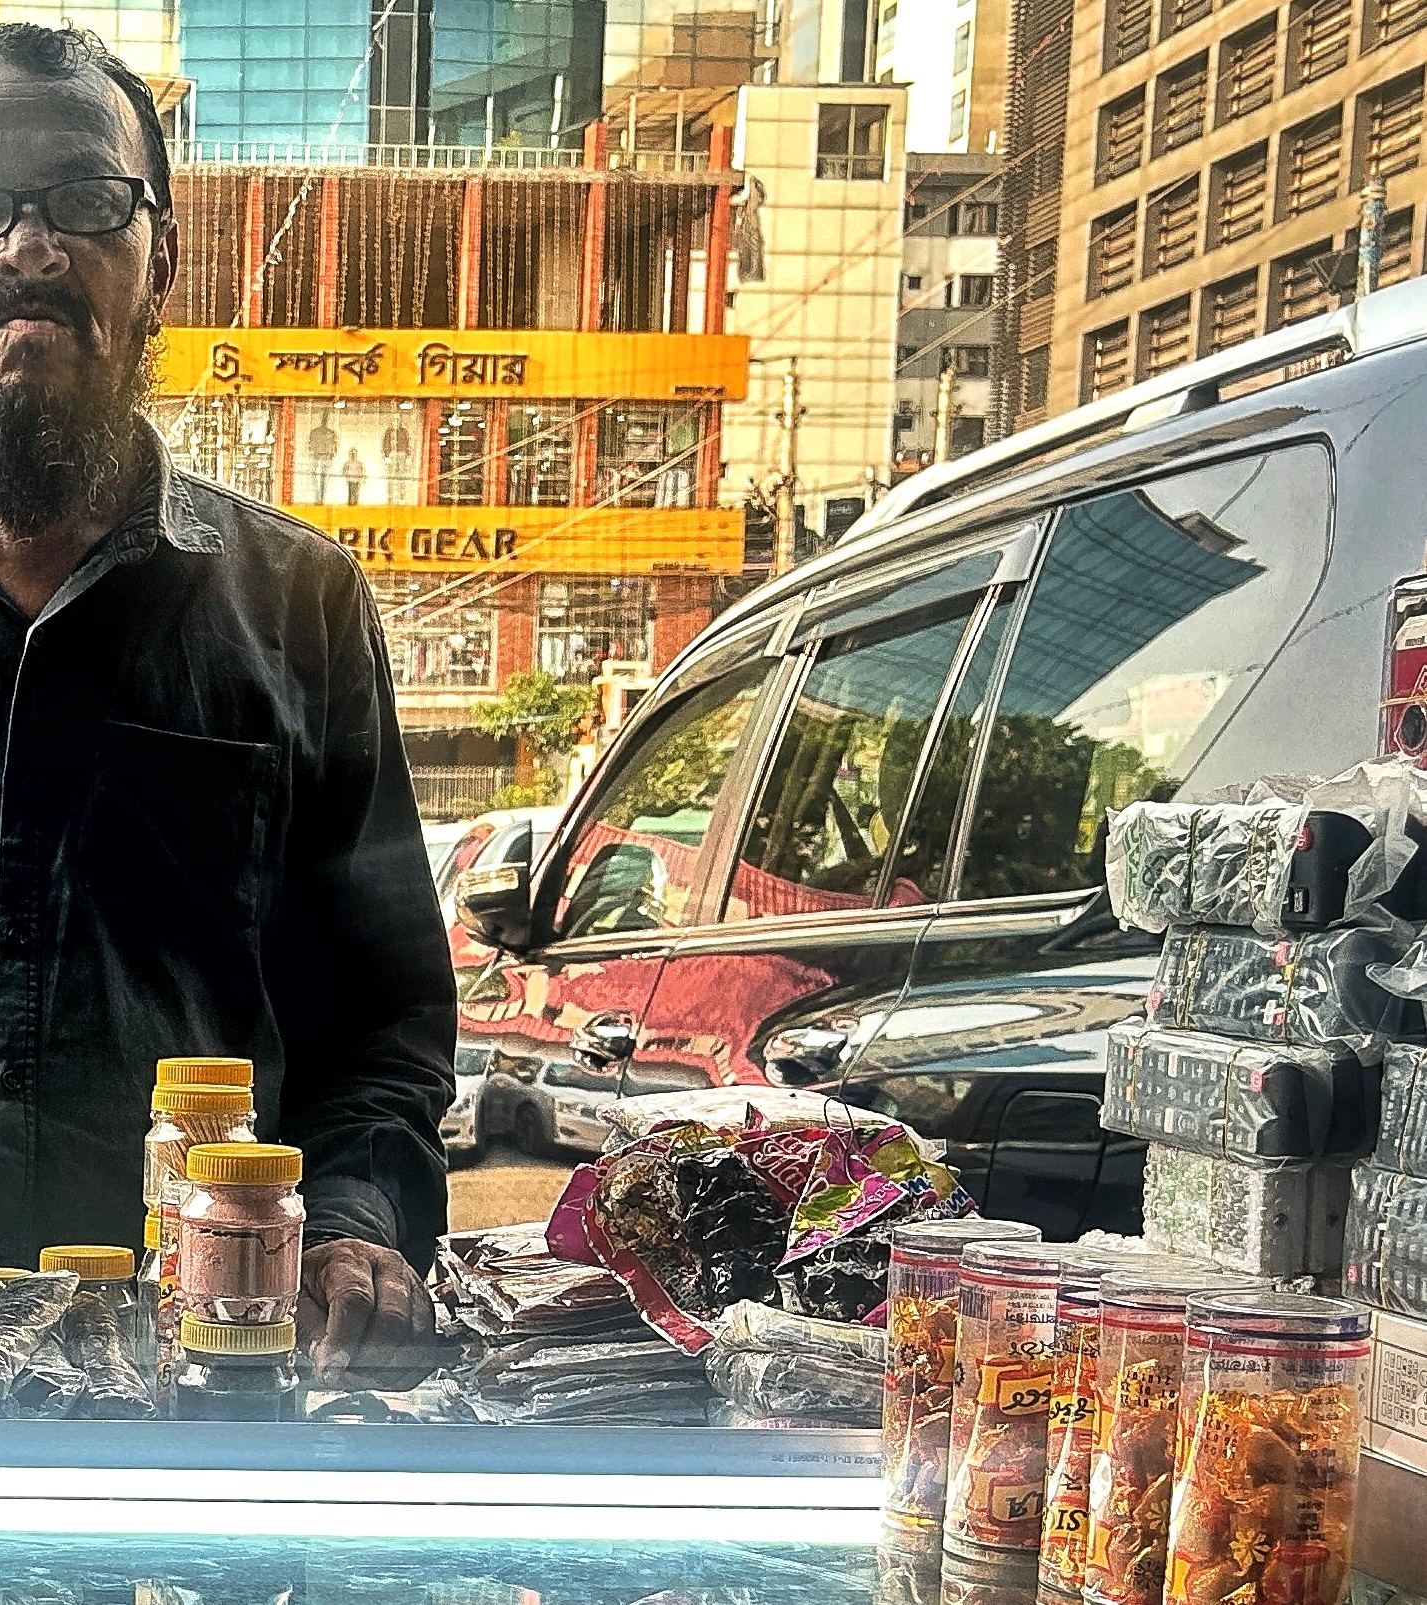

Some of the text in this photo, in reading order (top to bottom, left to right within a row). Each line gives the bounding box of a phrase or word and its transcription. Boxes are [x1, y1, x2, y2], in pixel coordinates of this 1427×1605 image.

[269, 342, 529, 385] স্পার্ক গিয়ার
[410, 527, 519, 561] GEAR
